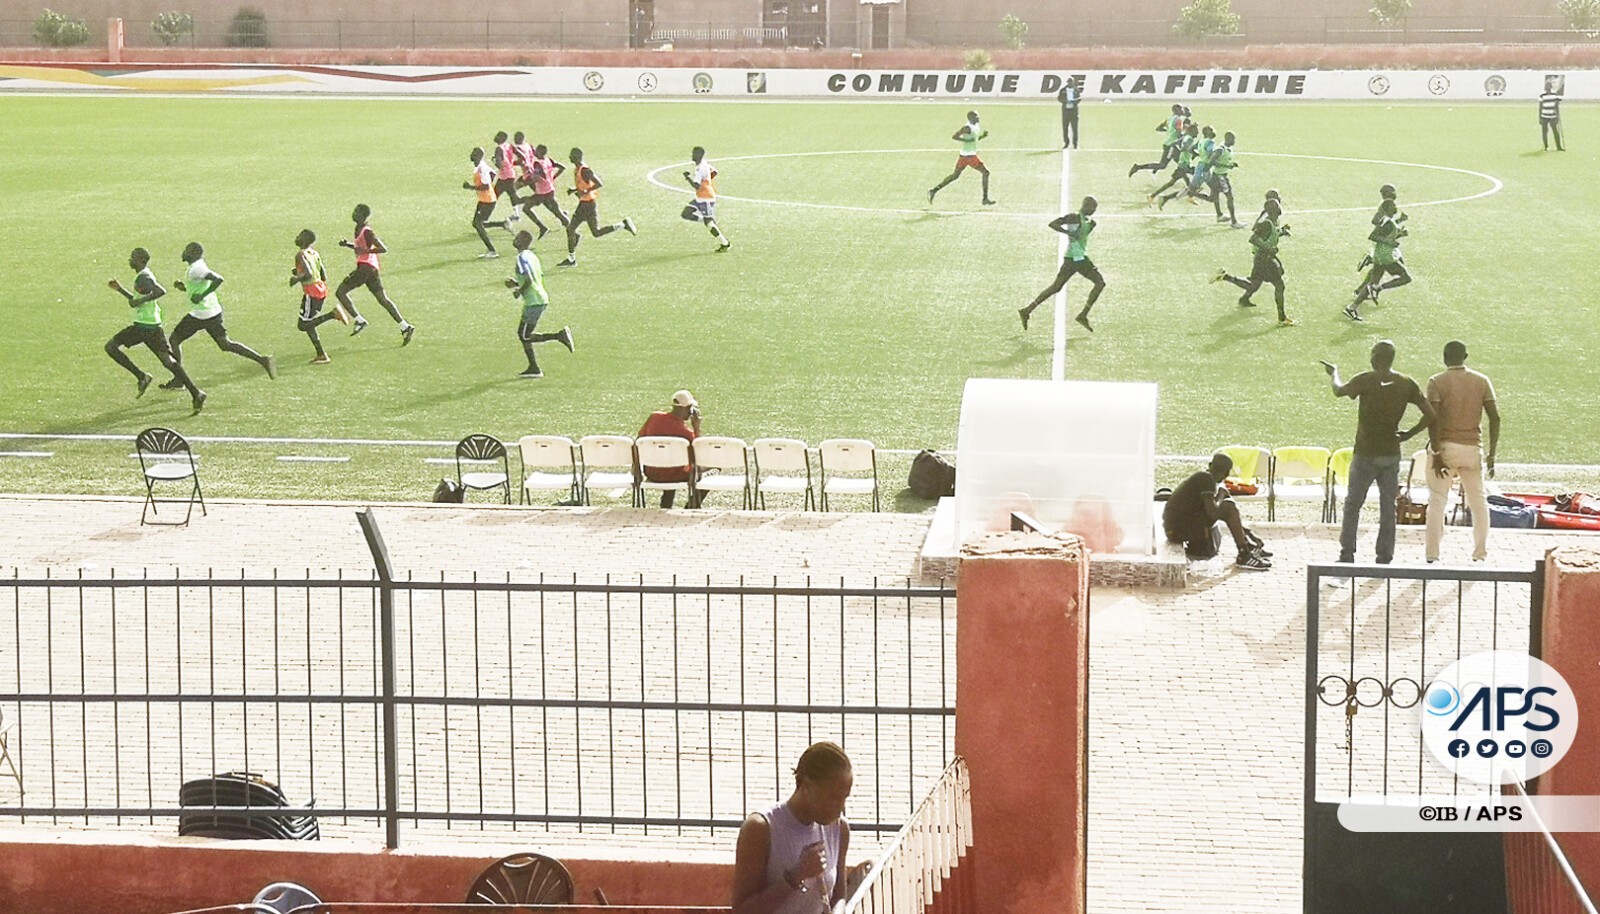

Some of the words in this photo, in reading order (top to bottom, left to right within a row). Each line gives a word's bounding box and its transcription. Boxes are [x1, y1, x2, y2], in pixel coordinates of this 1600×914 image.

[827, 73, 1020, 93] COMMUNE
[1040, 74, 1086, 93] DE
[1099, 74, 1306, 94] KAFFRINE
